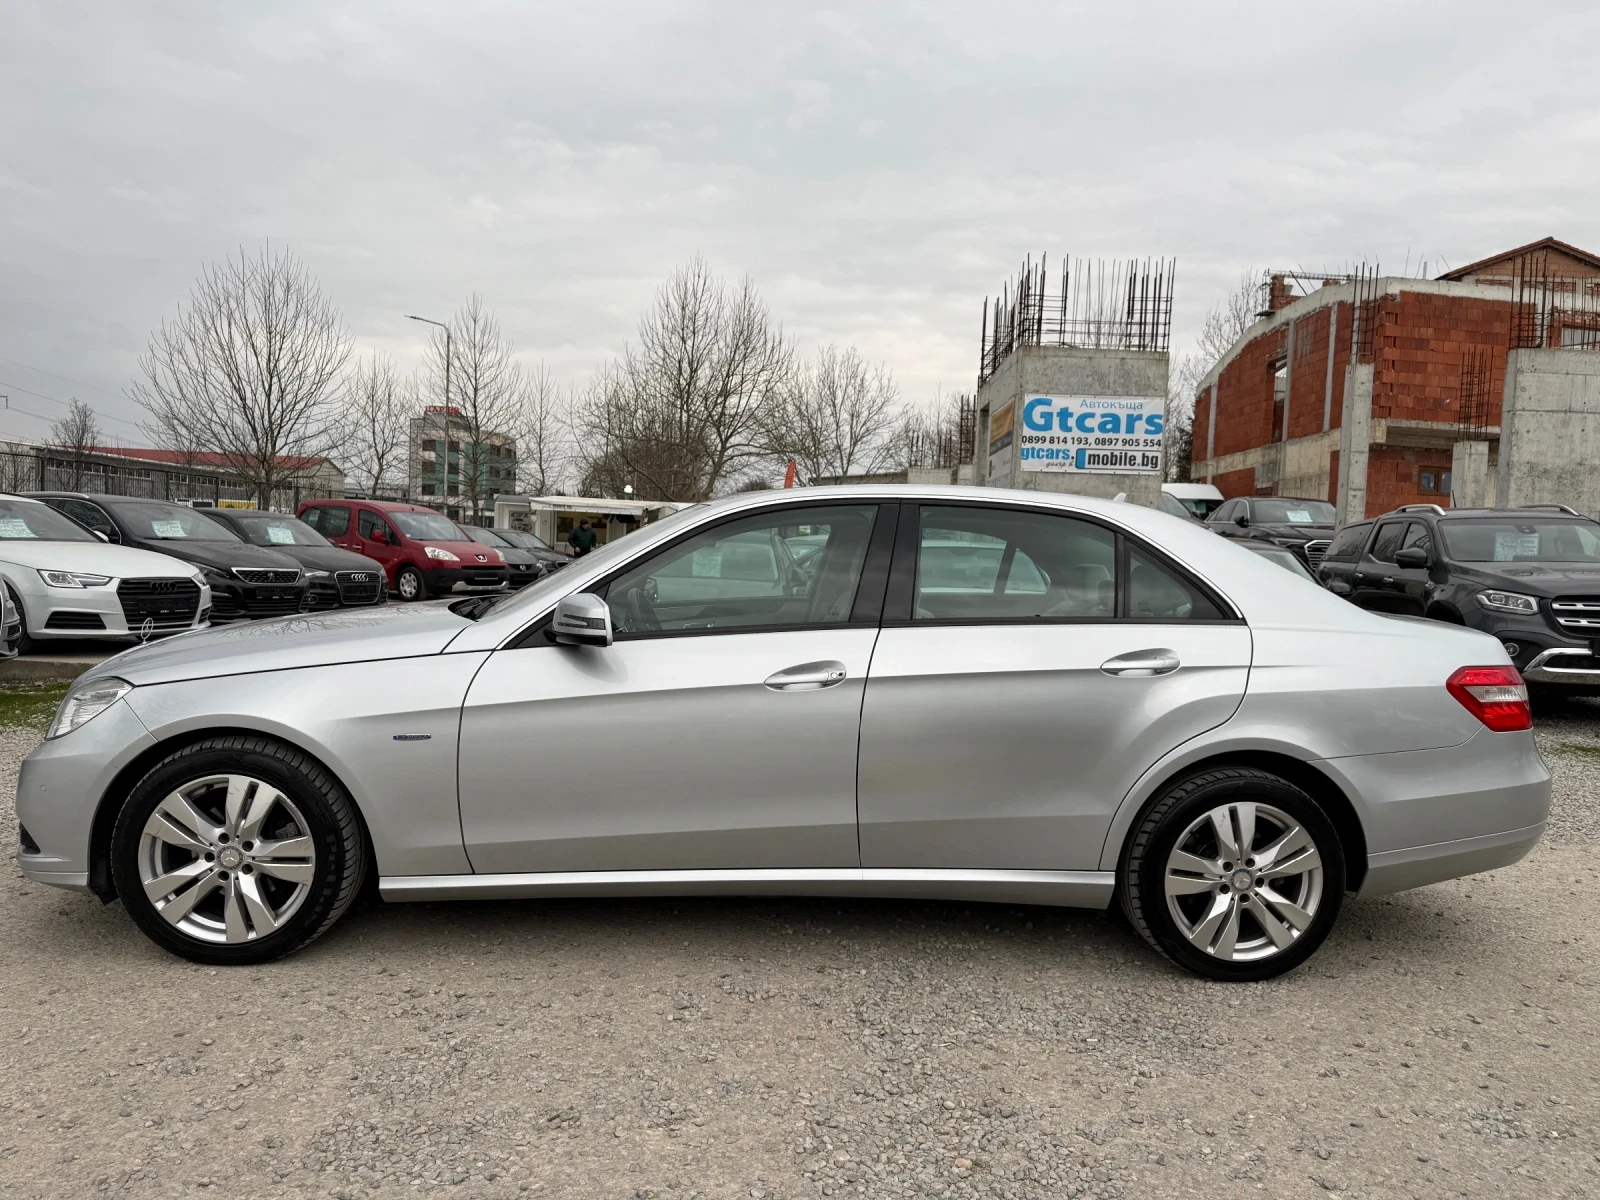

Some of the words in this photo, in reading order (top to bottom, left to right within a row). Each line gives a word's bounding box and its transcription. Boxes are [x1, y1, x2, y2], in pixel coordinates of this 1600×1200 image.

[1080, 399, 1143, 411] Автокъща
[1023, 397, 1163, 435] Gtcars
[1021, 435, 1047, 444] 0899
[1049, 436, 1068, 445] 814
[1071, 436, 1092, 446] 193,
[1094, 437, 1120, 446] 0897
[1121, 438, 1141, 447] 905
[1142, 438, 1162, 447] 554
[1087, 451, 1159, 469] mobile.bg
